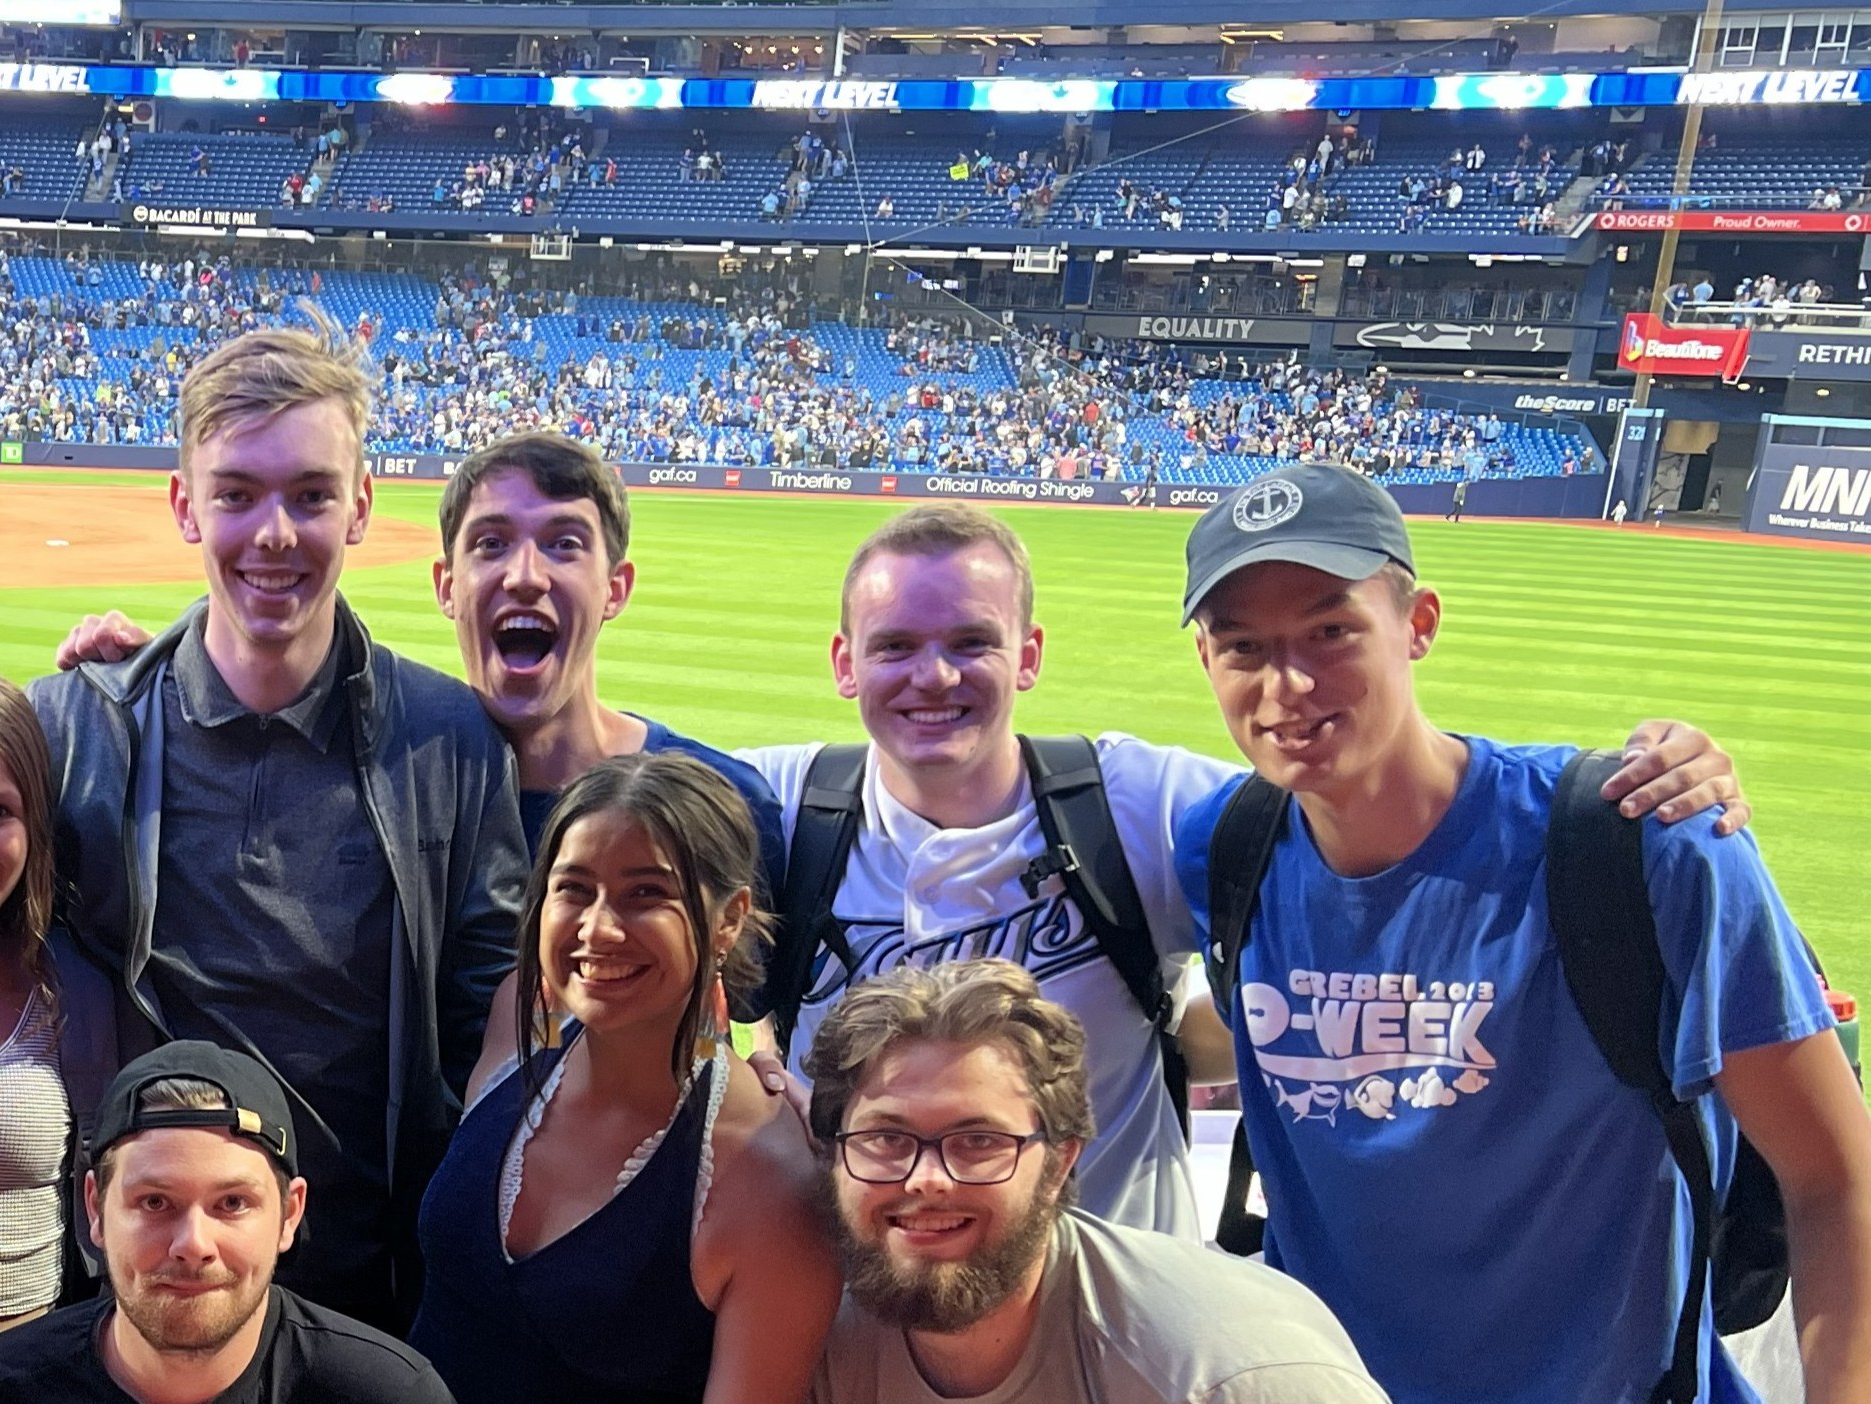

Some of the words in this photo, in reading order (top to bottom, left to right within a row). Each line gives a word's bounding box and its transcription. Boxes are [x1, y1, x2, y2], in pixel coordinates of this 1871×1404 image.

[19, 64, 90, 91] LEVEL
[821, 81, 900, 109] LEVEL
[1677, 72, 1770, 103] NEXT
[1762, 71, 1860, 102] LEVEL
[214, 211, 231, 224] THE
[232, 212, 256, 225] PARK
[1617, 214, 1675, 227] ROGERS
[1713, 216, 1751, 228] Proud
[1138, 317, 1254, 339] EQUALITY
[1515, 395, 1596, 412] theScore
[4, 447, 21, 459] TD
[385, 458, 417, 474] BET
[649, 467, 696, 483] gaf.ca
[770, 471, 852, 490] Timberline
[926, 477, 978, 494] Official
[981, 478, 1036, 498] Roofing
[1040, 480, 1094, 499] Shingle
[1170, 487, 1219, 505] gaf.ca
[1780, 464, 1871, 516] MN
[1769, 514, 1809, 528] Wherever
[1810, 517, 1849, 532] Business
[1240, 982, 1497, 1064] O-WEEK
